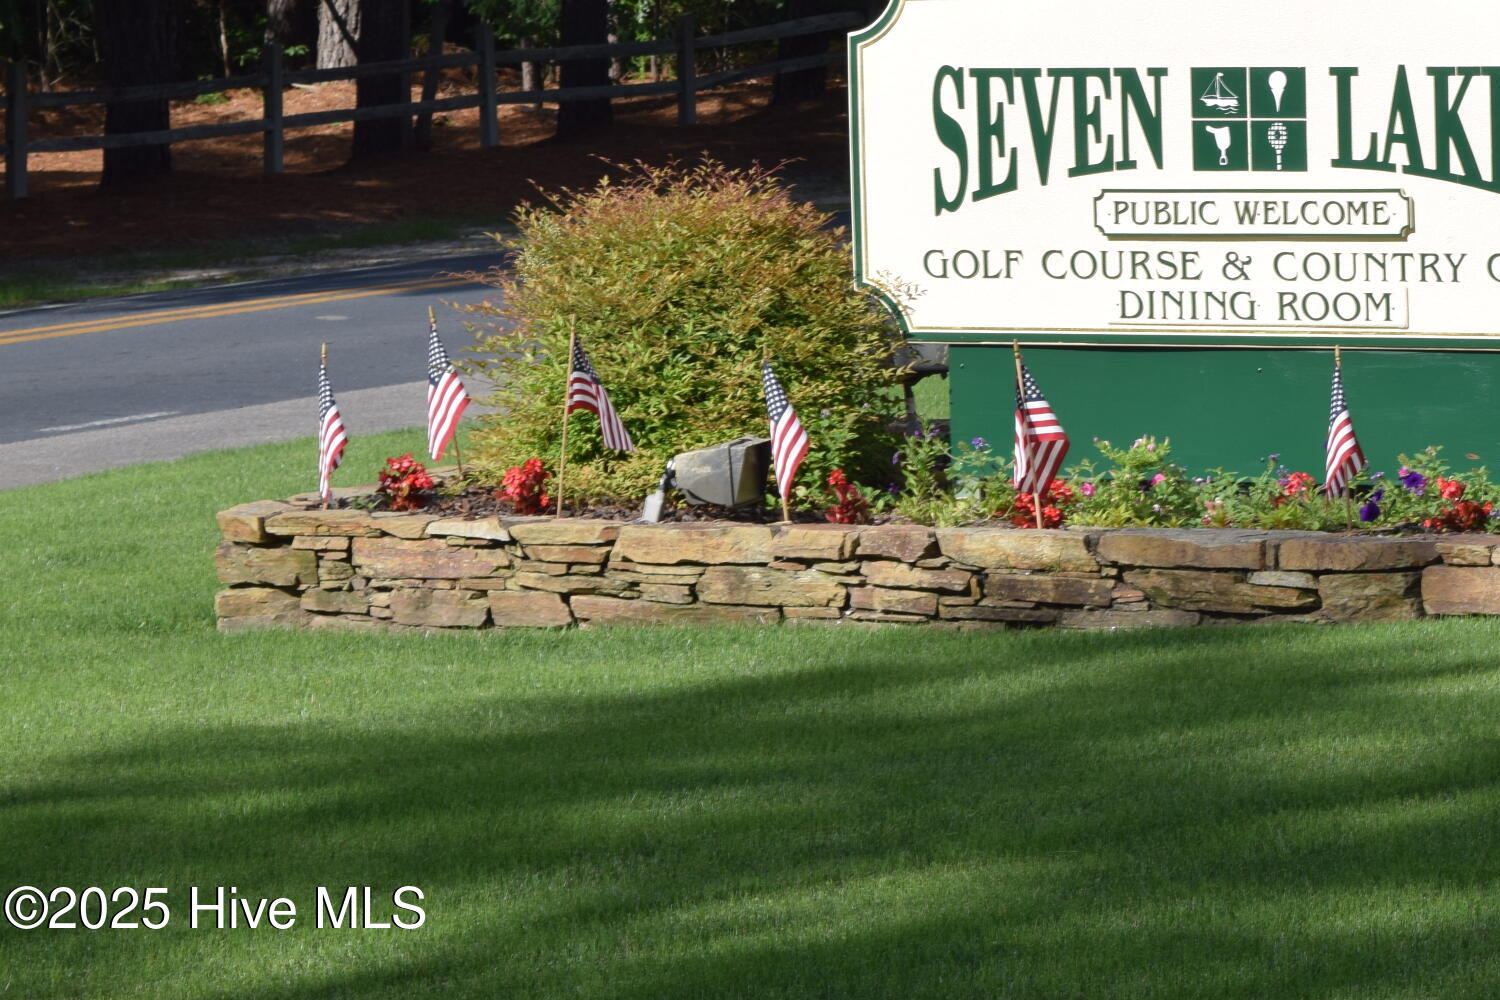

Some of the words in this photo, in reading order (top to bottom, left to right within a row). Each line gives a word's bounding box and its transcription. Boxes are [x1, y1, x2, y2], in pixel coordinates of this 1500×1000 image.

[932, 65, 1168, 216] SEVEN
[1113, 200, 1219, 226] PUBLIC
[1234, 200, 1390, 226] WELCOME
[923, 249, 1023, 279] GOLF
[1041, 250, 1202, 281] COURSE
[1222, 251, 1252, 281] &
[1273, 251, 1467, 283] COUNTRY
[1119, 290, 1256, 320] DINING
[1277, 292, 1392, 321] ROOM
